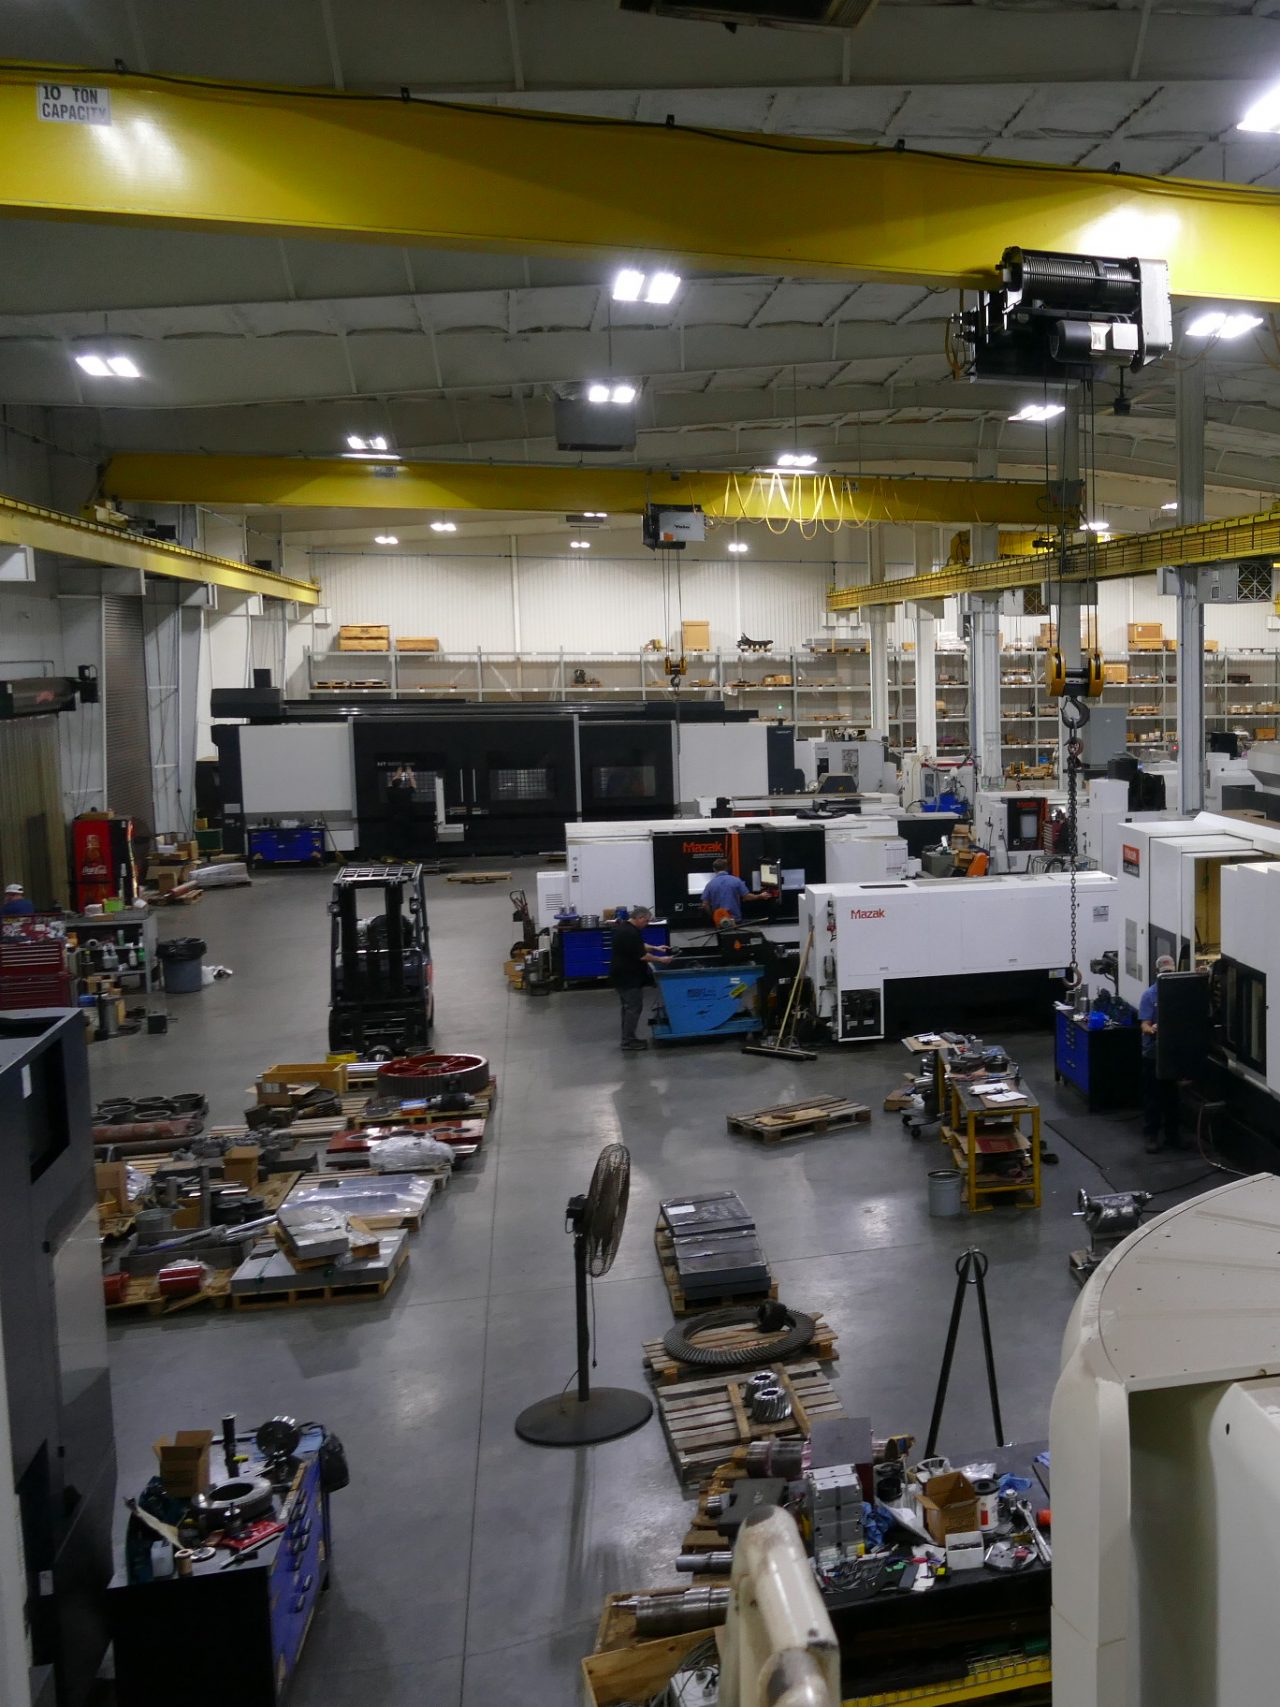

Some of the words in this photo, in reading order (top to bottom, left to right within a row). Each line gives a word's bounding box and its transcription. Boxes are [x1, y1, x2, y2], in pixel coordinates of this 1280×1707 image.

[43, 85, 61, 101] 10
[72, 87, 98, 105] TON
[42, 103, 107, 121] CAPACITY
[683, 841, 722, 853] Mazak
[850, 908, 885, 920] Mazak
